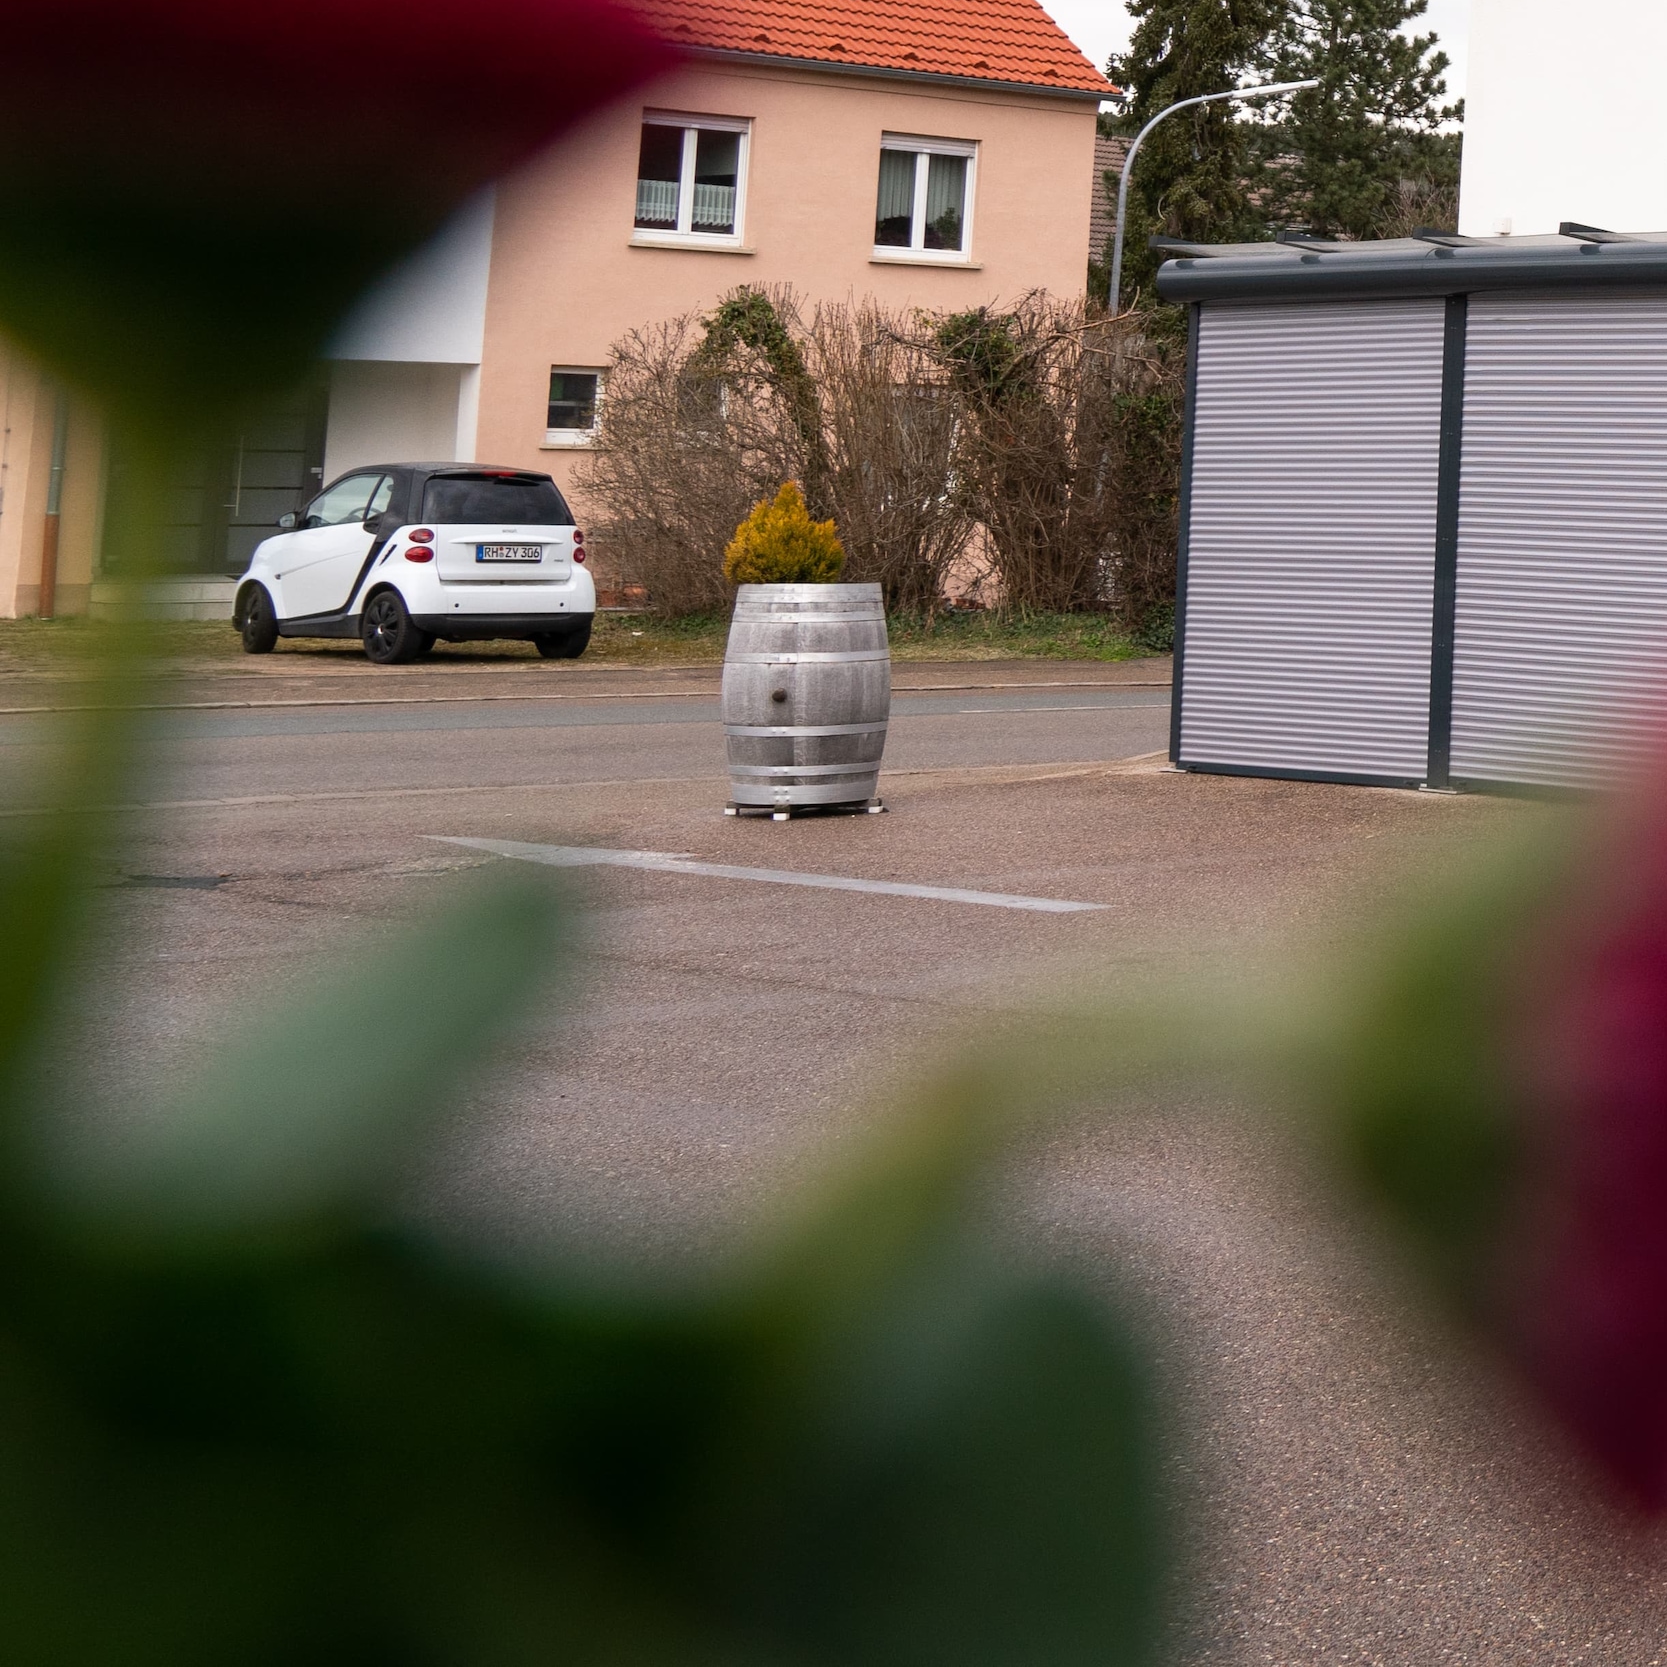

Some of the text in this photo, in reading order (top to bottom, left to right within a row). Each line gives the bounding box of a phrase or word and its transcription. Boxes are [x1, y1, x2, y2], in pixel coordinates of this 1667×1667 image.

[484, 547, 540, 558] RH ZY 306
